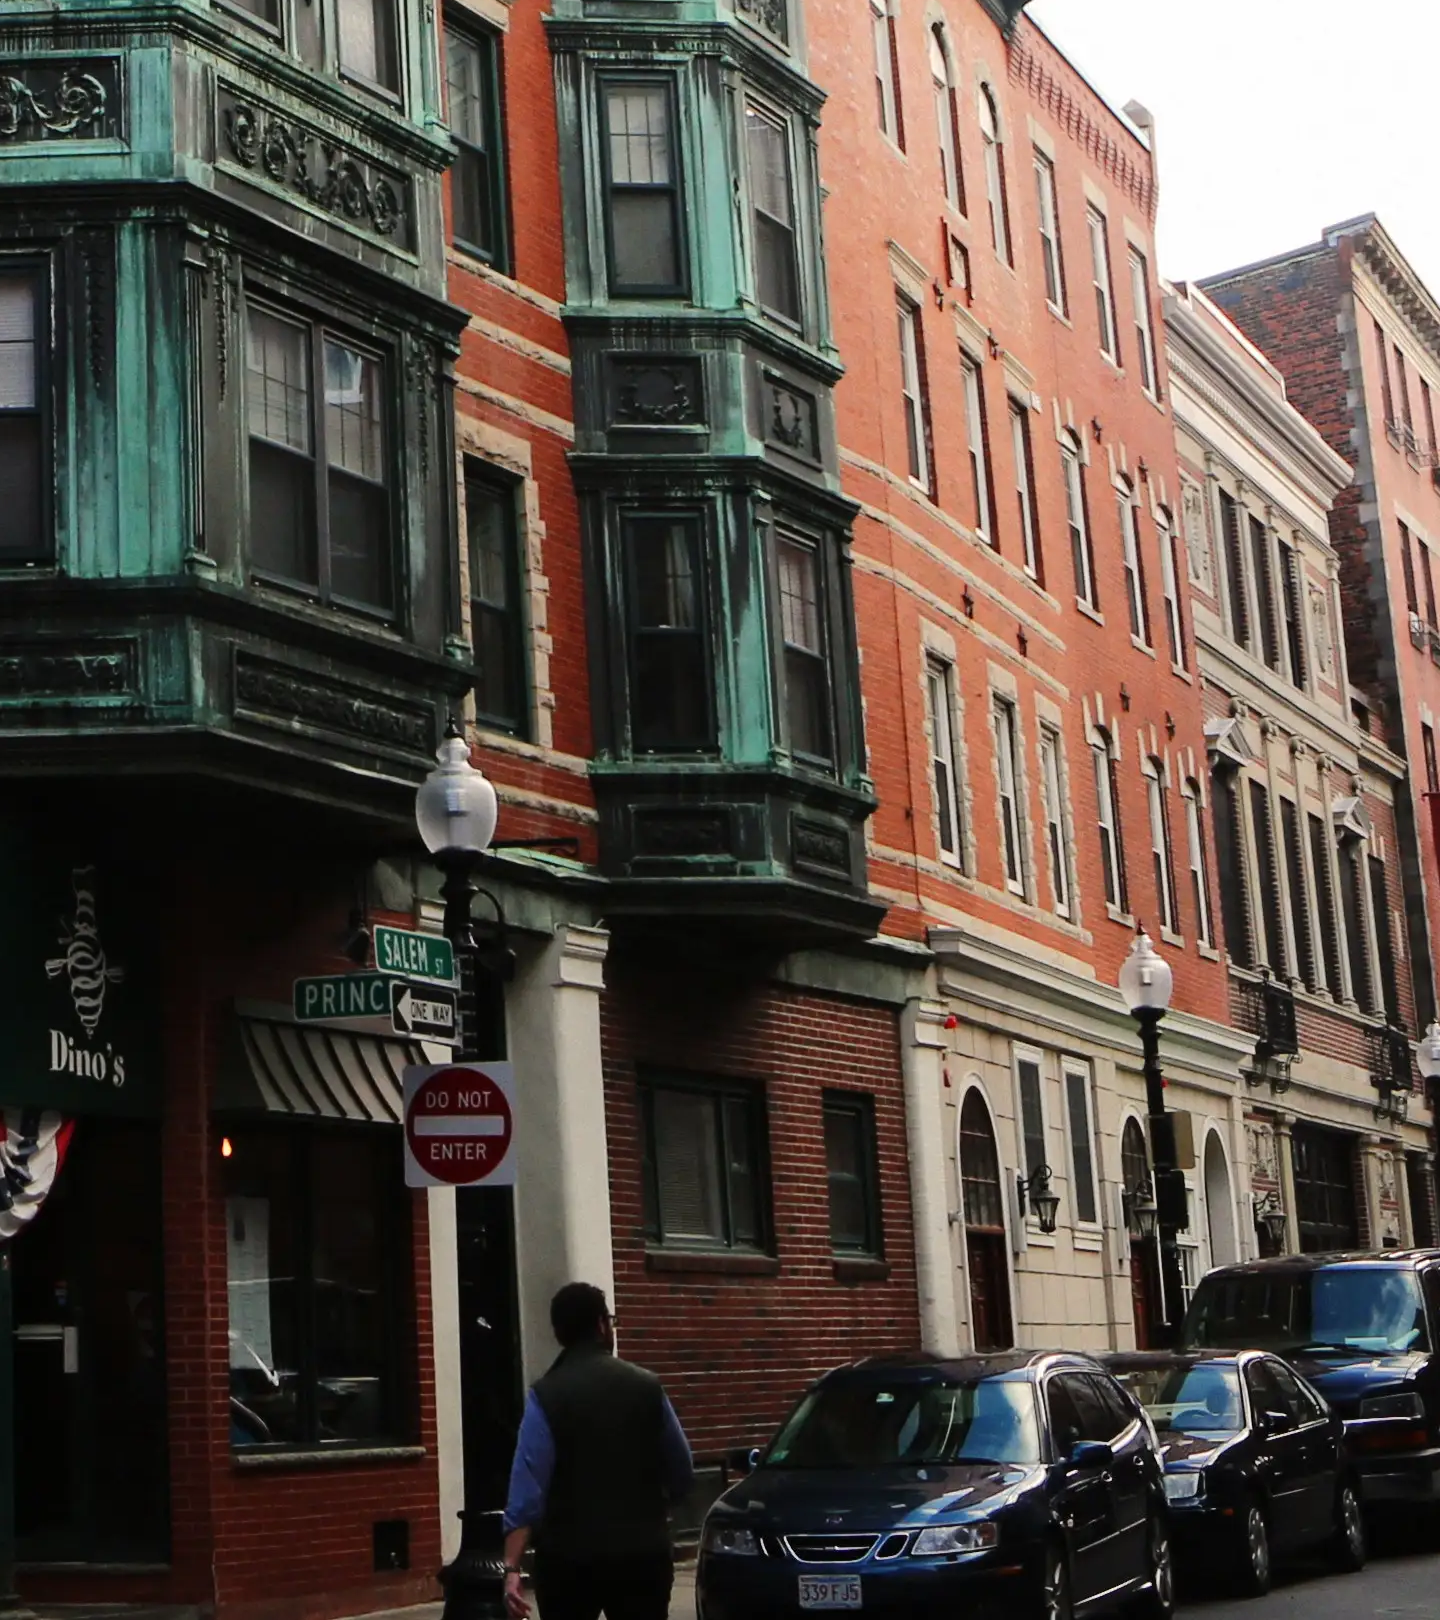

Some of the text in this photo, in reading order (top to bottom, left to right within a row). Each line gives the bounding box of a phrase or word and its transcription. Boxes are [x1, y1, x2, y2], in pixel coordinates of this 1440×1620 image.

[383, 932, 444, 976] SALEM ST
[305, 981, 392, 1015] PRINC
[411, 999, 451, 1023] ONE WAY
[49, 1028, 125, 1087] Dino's
[425, 1091, 492, 1108] DO NOT
[430, 1143, 487, 1160] ENTER
[802, 1583, 828, 1601] 339
